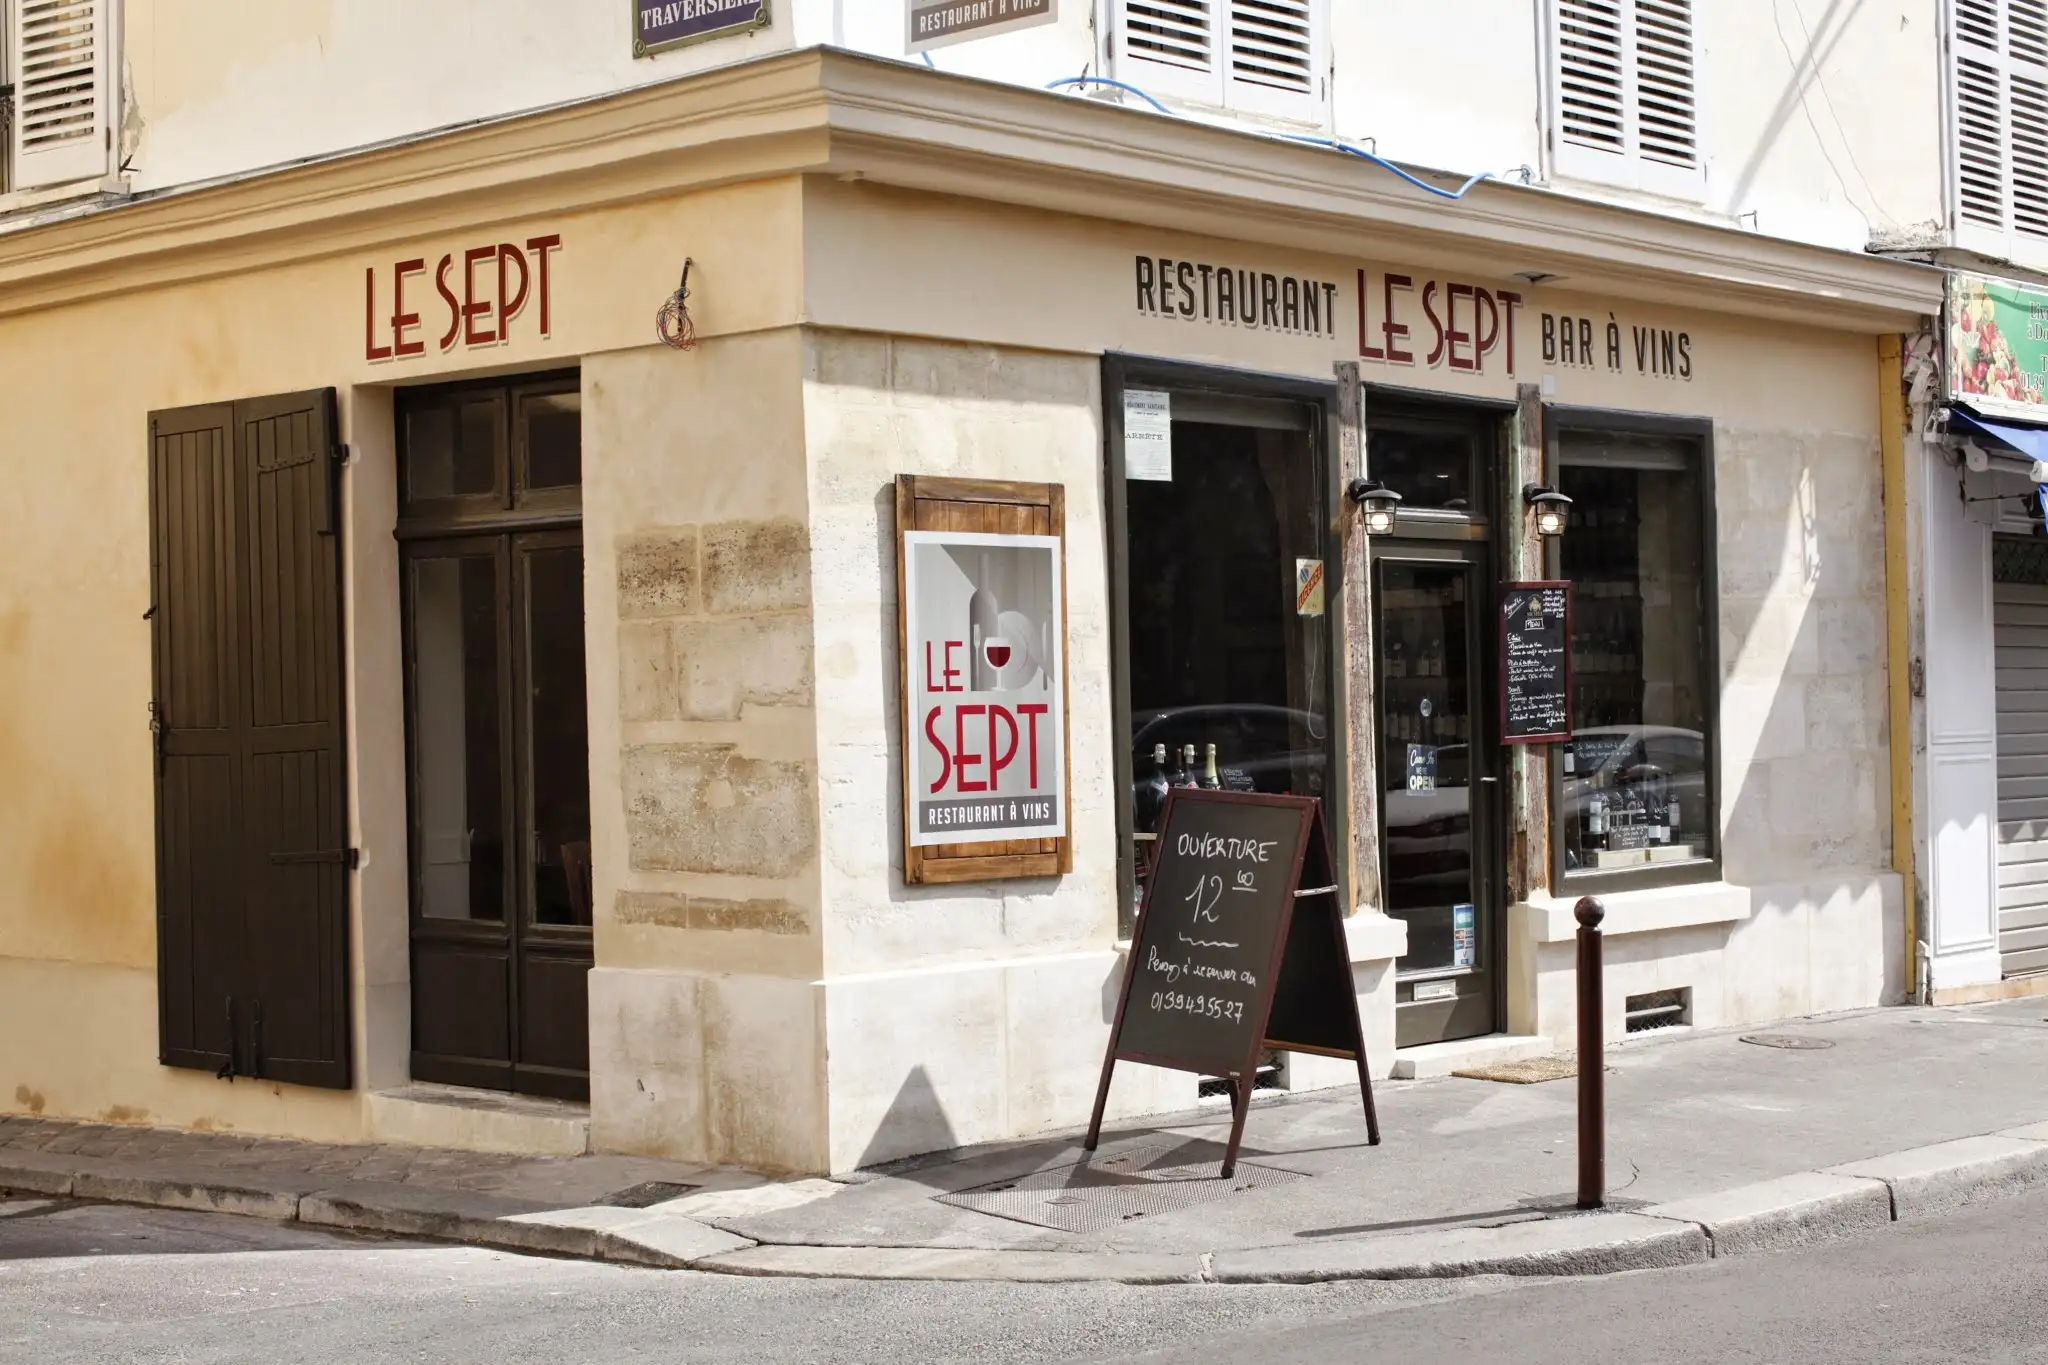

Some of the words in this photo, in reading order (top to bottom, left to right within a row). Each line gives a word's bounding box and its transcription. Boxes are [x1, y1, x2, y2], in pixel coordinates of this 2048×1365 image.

[920, 1, 993, 33] RESTAURANT
[366, 258, 425, 361] LE
[435, 233, 561, 351] SEPT
[1135, 255, 1337, 336] RESTAURANT
[1357, 268, 1414, 363] LE
[1422, 280, 1522, 376] SEPT
[1541, 312, 1594, 366] BAR
[1606, 311, 1621, 370] À
[1632, 325, 1692, 378] VINS
[926, 641, 963, 692] LE
[925, 703, 1048, 794] SEPT
[1409, 774, 1435, 792] OPEN
[928, 804, 1005, 825] RESTAURANT
[1009, 801, 1017, 820] À
[1022, 802, 1050, 820] VINS
[1178, 832, 1278, 863] OUVERTURE
[1185, 874, 1223, 923] 12
[1240, 971, 1256, 987] au
